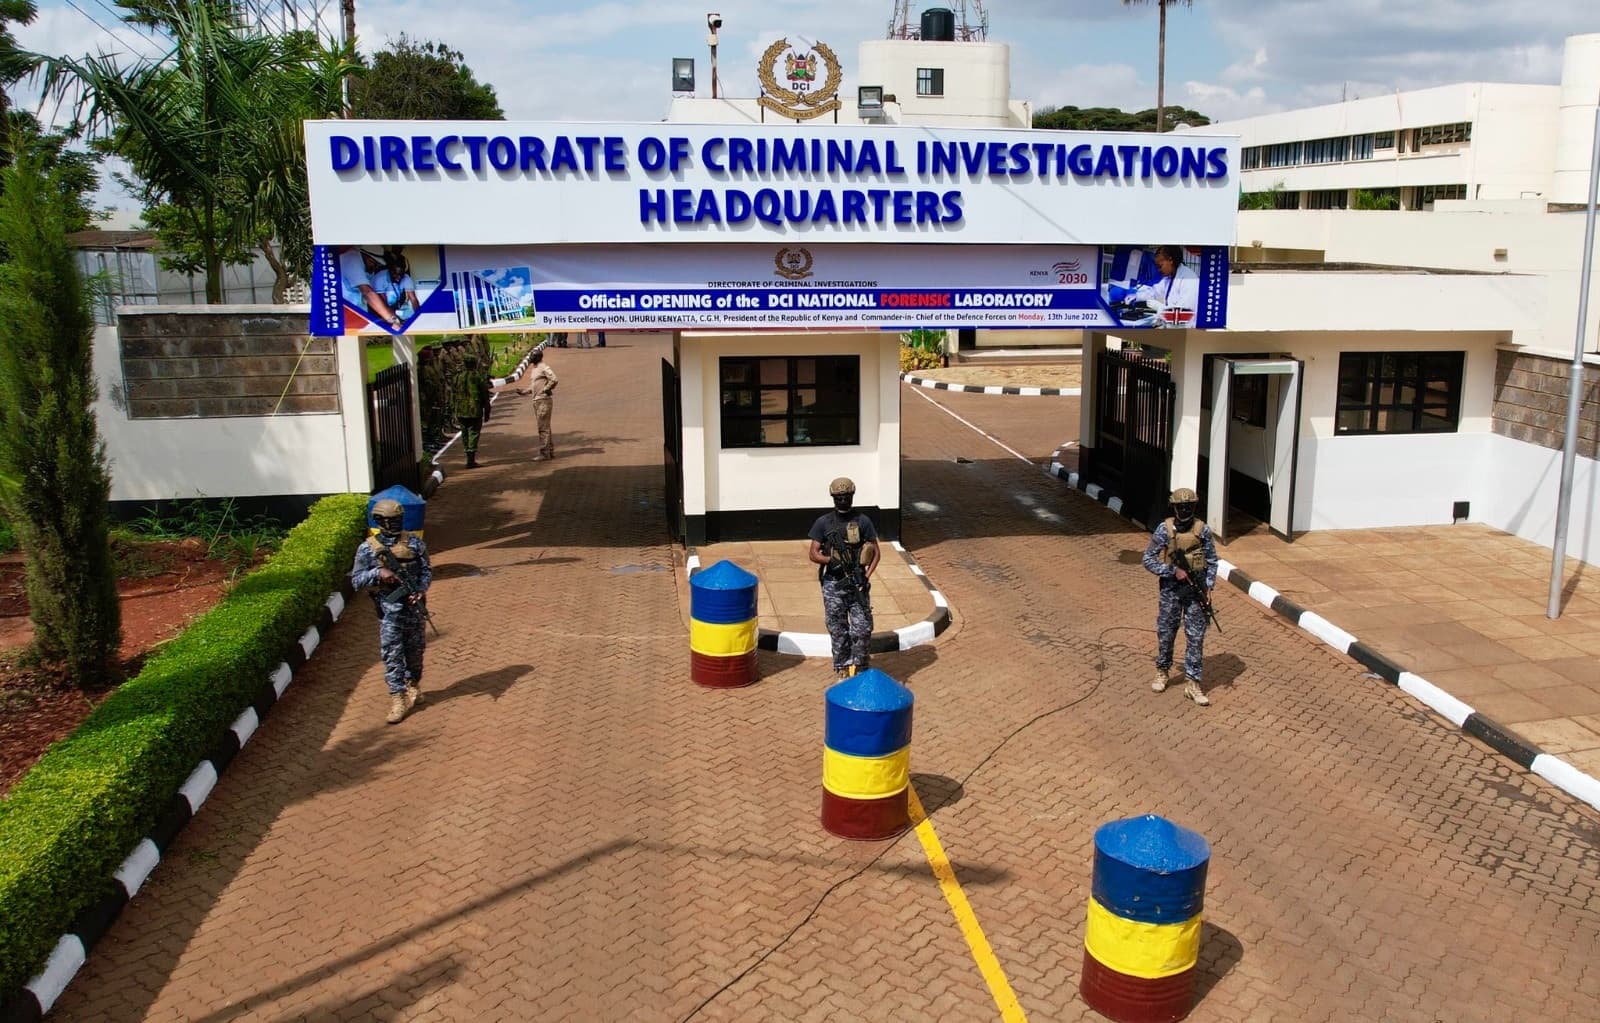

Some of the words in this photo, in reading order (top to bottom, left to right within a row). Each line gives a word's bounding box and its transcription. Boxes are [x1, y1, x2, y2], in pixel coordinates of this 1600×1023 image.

[792, 82, 810, 91] DCI
[329, 135, 626, 172] DIRECTORATE
[638, 137, 689, 172] OF
[702, 137, 905, 174] CRIMINAL
[917, 141, 1229, 180] INVESTIGATIONS
[640, 188, 963, 226] HEADQUARTERS
[774, 280, 811, 288] CRIMINAL
[814, 280, 878, 288] INVESTIGATIONS
[1059, 273, 1088, 284] 2030
[578, 294, 635, 309] Official
[640, 294, 712, 309] OPENING
[716, 294, 732, 308] of
[735, 294, 760, 308] the
[768, 294, 793, 308] DCI
[797, 293, 877, 308] NATIONAL
[880, 293, 951, 308] FORENSIC
[954, 293, 1054, 307] LABORATORY
[543, 315, 552, 324] By
[554, 315, 567, 324] His
[568, 315, 606, 324] Excellency
[608, 315, 627, 323] HON.
[629, 315, 656, 323] UHURU
[658, 315, 698, 324] KENYATTA,
[700, 314, 721, 323] C.G.H,
[723, 314, 757, 322] President
[758, 314, 766, 322] of
[767, 314, 780, 322] the
[781, 314, 812, 323] Republic
[821, 314, 844, 323] Kenya
[915, 313, 933, 321] Chief
[934, 313, 943, 321] of
[943, 313, 955, 321] the
[956, 313, 984, 321] Defence
[984, 313, 1007, 321] Forces
[1018, 313, 1046, 322] Monday,
[1047, 313, 1063, 321] 13th
[1064, 313, 1080, 321] June
[1081, 313, 1098, 321] 2022
